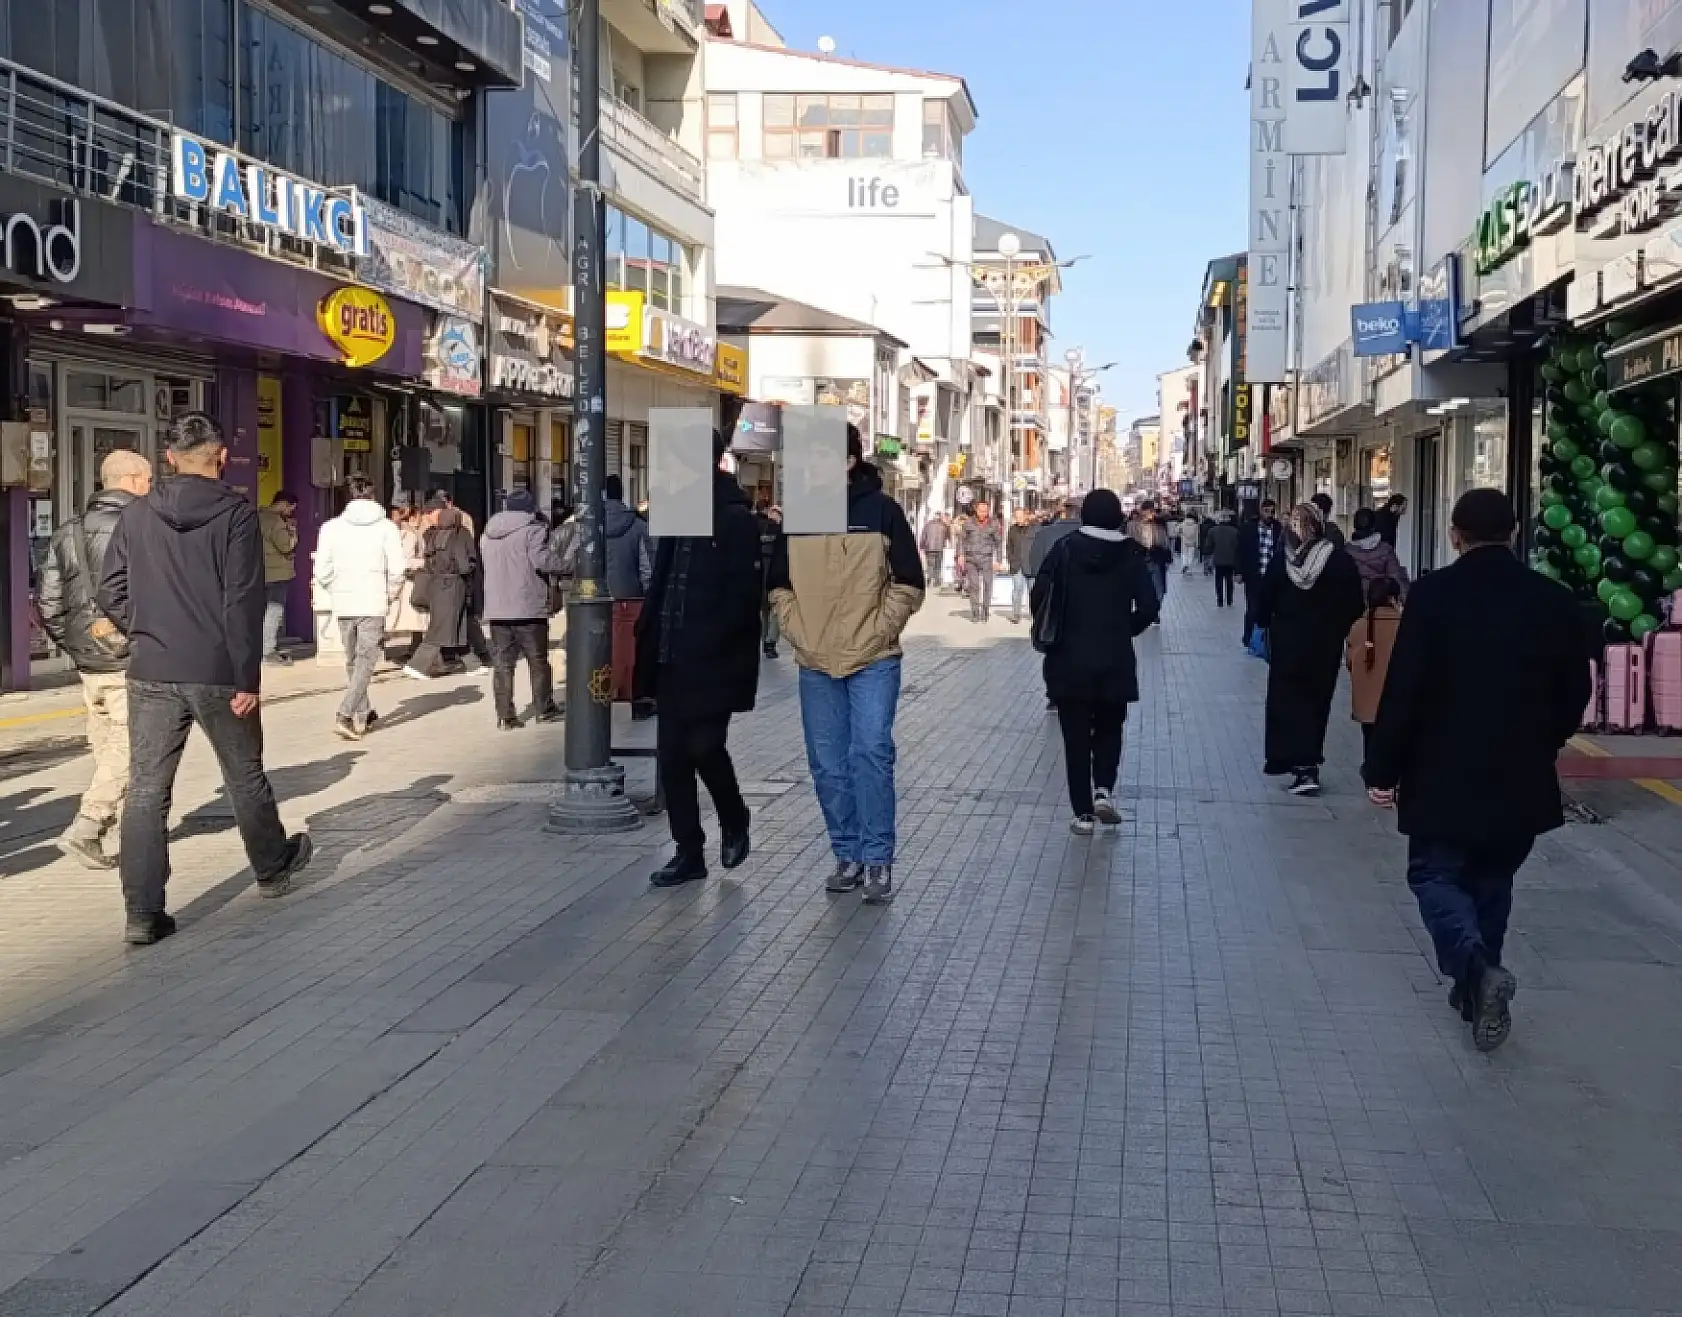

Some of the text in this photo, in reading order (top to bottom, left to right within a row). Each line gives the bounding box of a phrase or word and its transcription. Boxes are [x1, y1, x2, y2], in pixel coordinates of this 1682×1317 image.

[848, 176, 900, 208] life
[0, 198, 80, 283] nd
[342, 304, 387, 336] gratis
